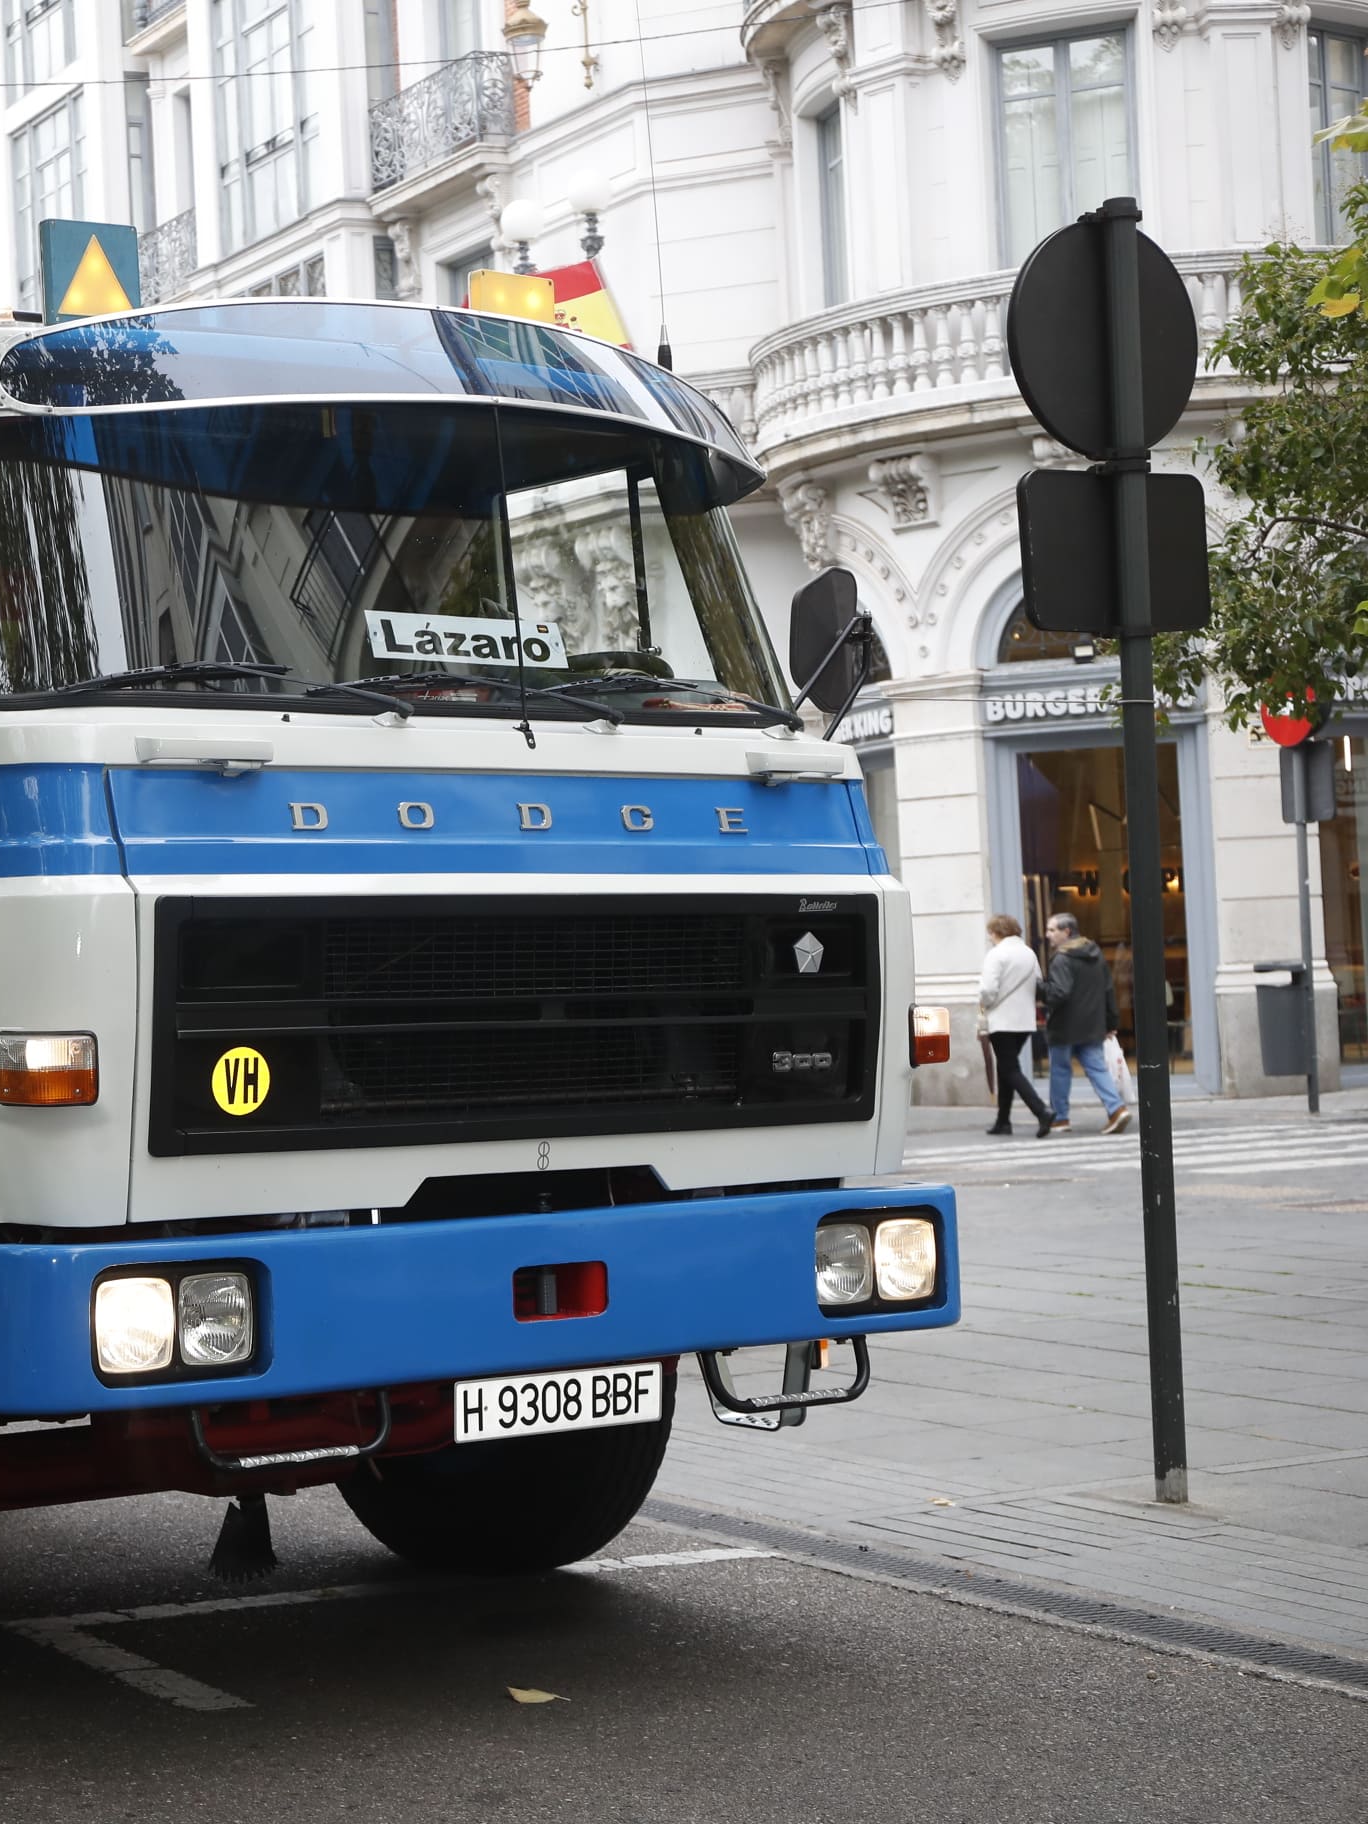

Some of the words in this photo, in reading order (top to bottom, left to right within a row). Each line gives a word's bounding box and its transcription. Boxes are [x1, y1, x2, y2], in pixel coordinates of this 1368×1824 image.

[380, 619, 551, 662] Lázaro
[986, 687, 1109, 721] BURGER
[287, 801, 749, 834] DODGE
[224, 1057, 259, 1105] VH
[463, 1387, 483, 1434] H
[498, 1378, 582, 1429] 9308
[591, 1370, 654, 1418] BBF
